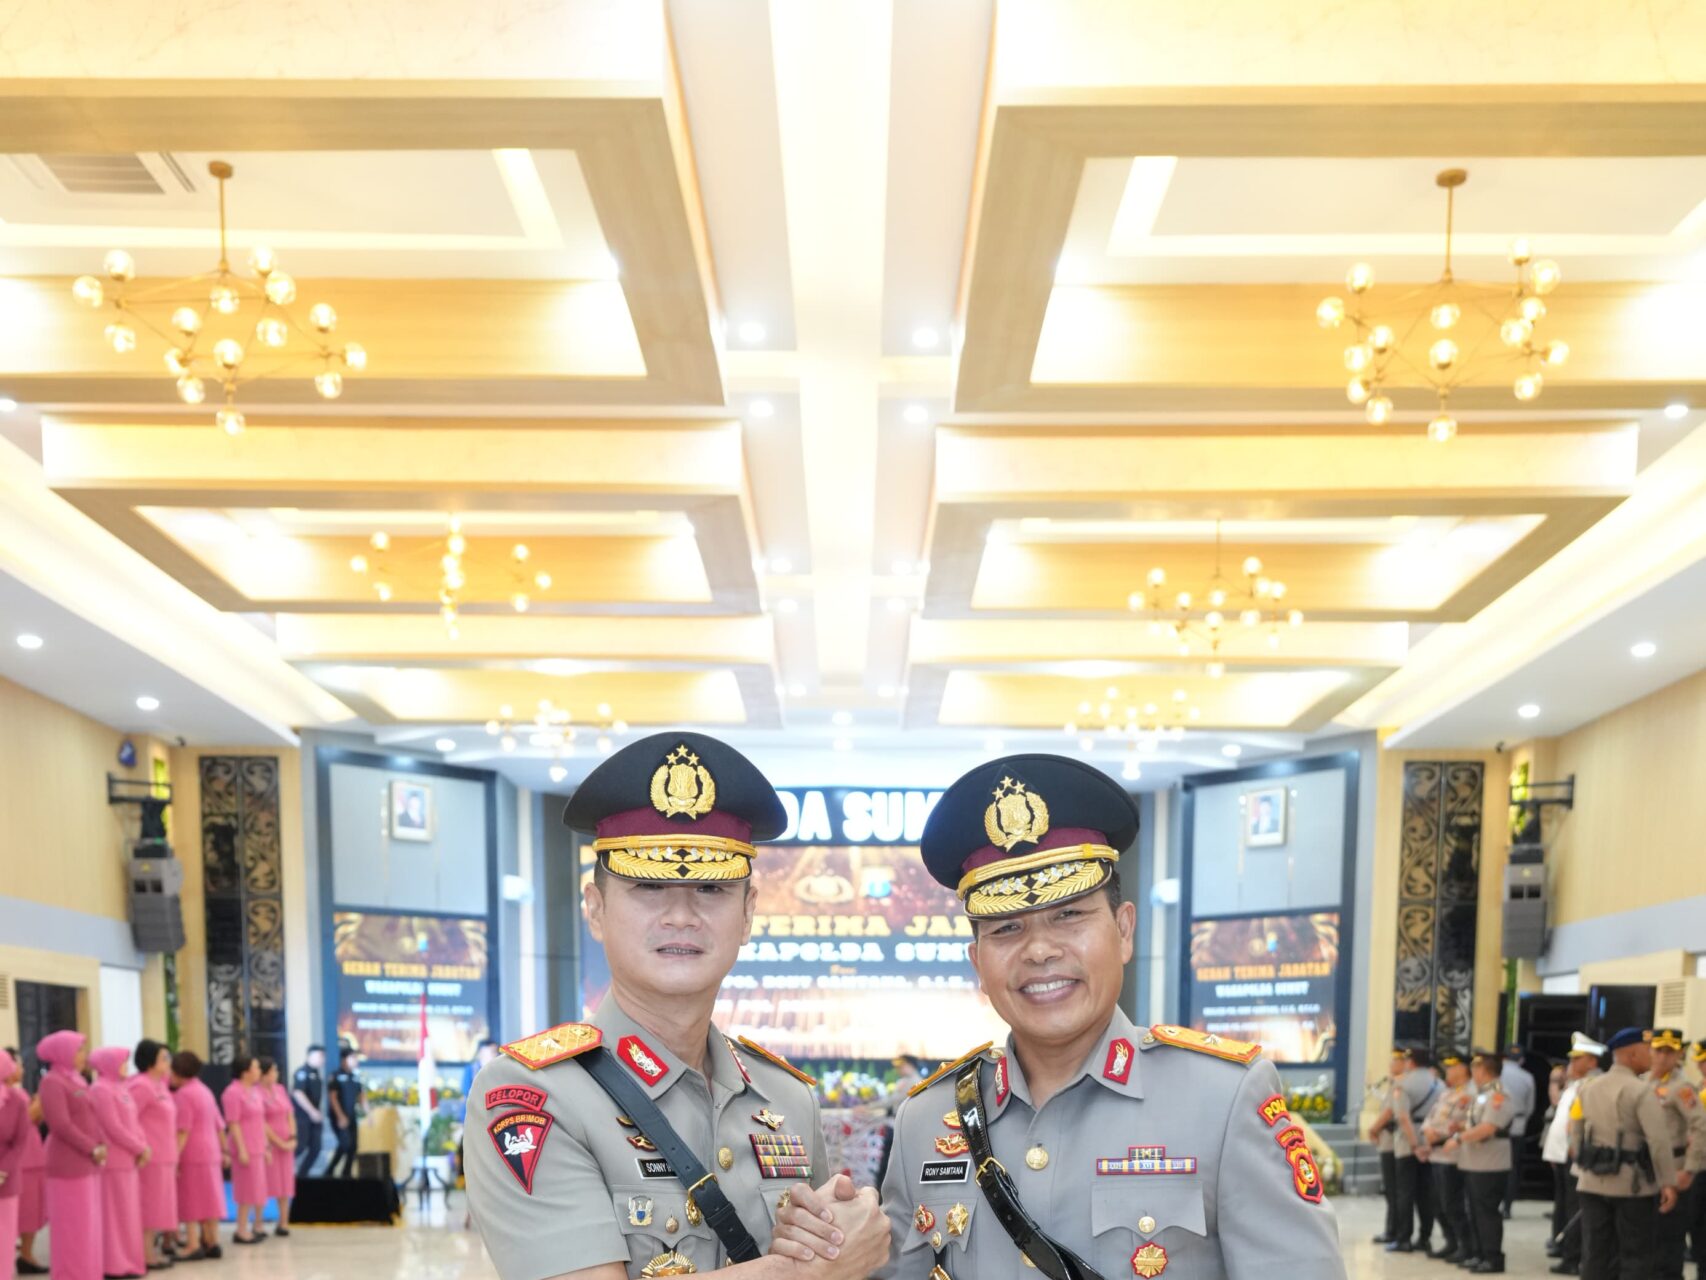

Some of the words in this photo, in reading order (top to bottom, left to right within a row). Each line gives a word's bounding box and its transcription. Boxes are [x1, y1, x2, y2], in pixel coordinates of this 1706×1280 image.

[490, 1089, 539, 1105] PELOPOR
[493, 1115, 515, 1134] KORPS
[515, 1114, 547, 1126] BRIMOB
[645, 1162, 667, 1172] SONNY
[925, 1167, 939, 1176] RONY
[939, 1166, 963, 1175] SAMTANA
